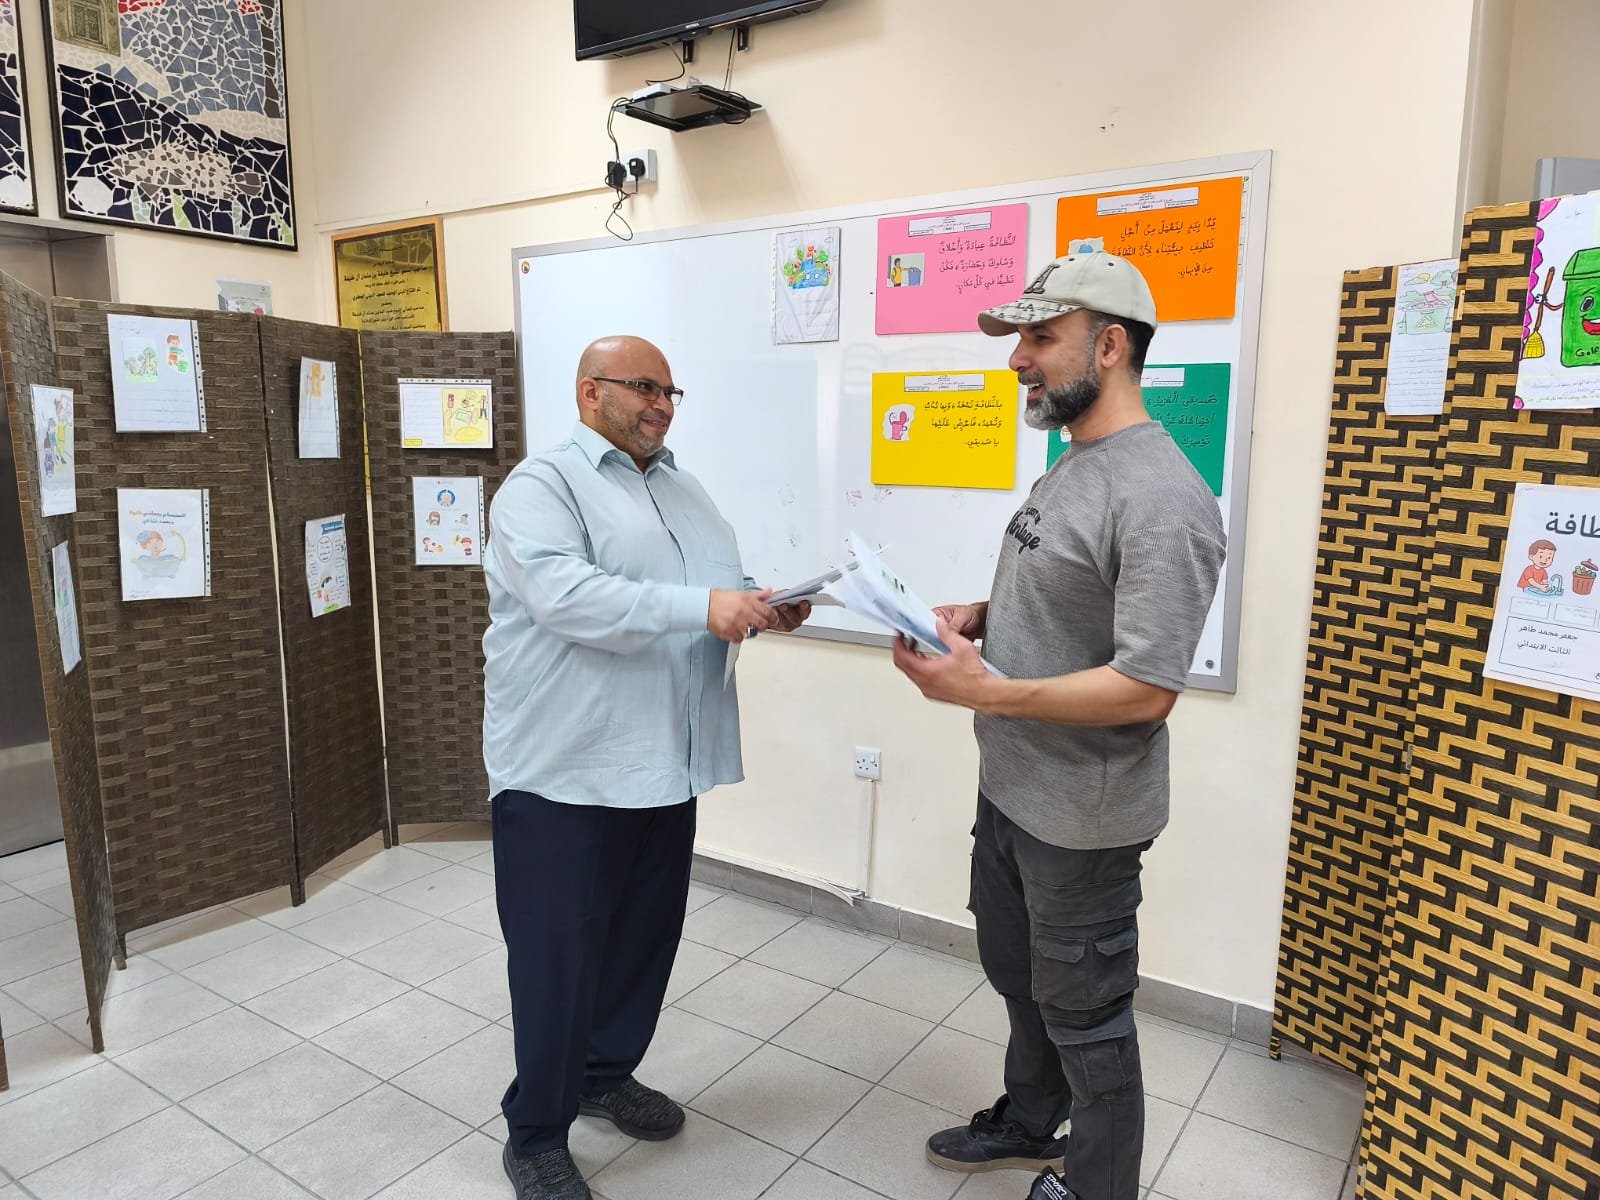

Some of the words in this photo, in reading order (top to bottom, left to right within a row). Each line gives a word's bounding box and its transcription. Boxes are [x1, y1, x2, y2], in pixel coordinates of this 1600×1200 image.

[1518, 624, 1536, 633] طاهر
[1559, 633, 1578, 642] جعفر
[1517, 639, 1547, 650] الابتدائي
[1548, 646, 1571, 655] الثالث
